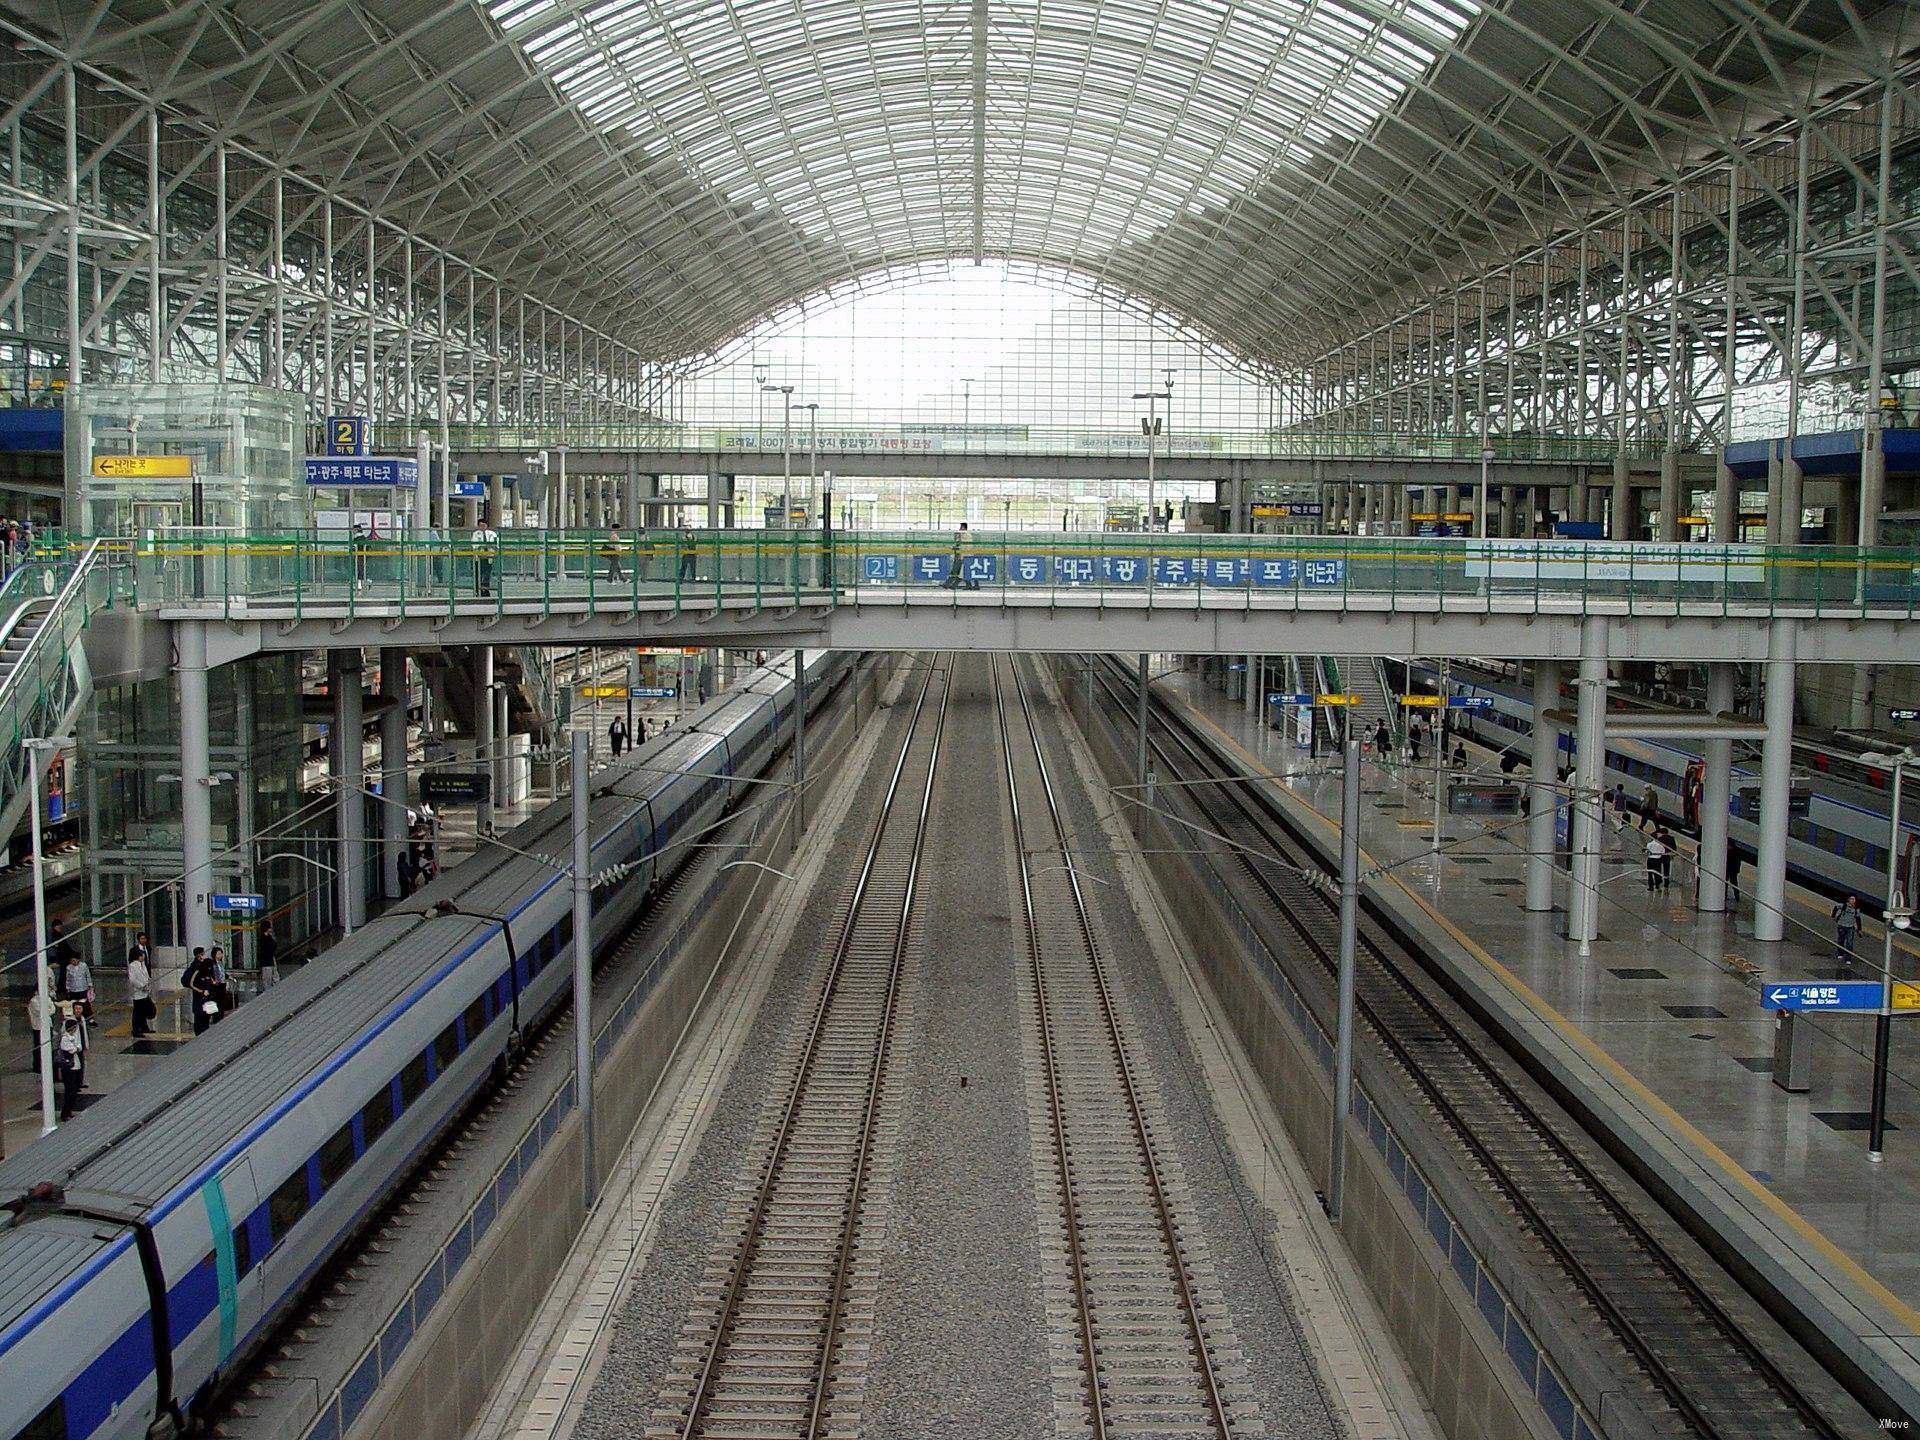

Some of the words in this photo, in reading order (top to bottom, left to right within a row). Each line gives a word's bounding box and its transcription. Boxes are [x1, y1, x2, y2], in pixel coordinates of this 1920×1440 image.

[338, 423, 353, 443] 2
[363, 423, 370, 443] 2
[305, 466, 361, 480] 구·광주·목포
[364, 466, 391, 480] 타는곳
[871, 560, 882, 575] 2
[1305, 562, 1336, 584] 타는곳
